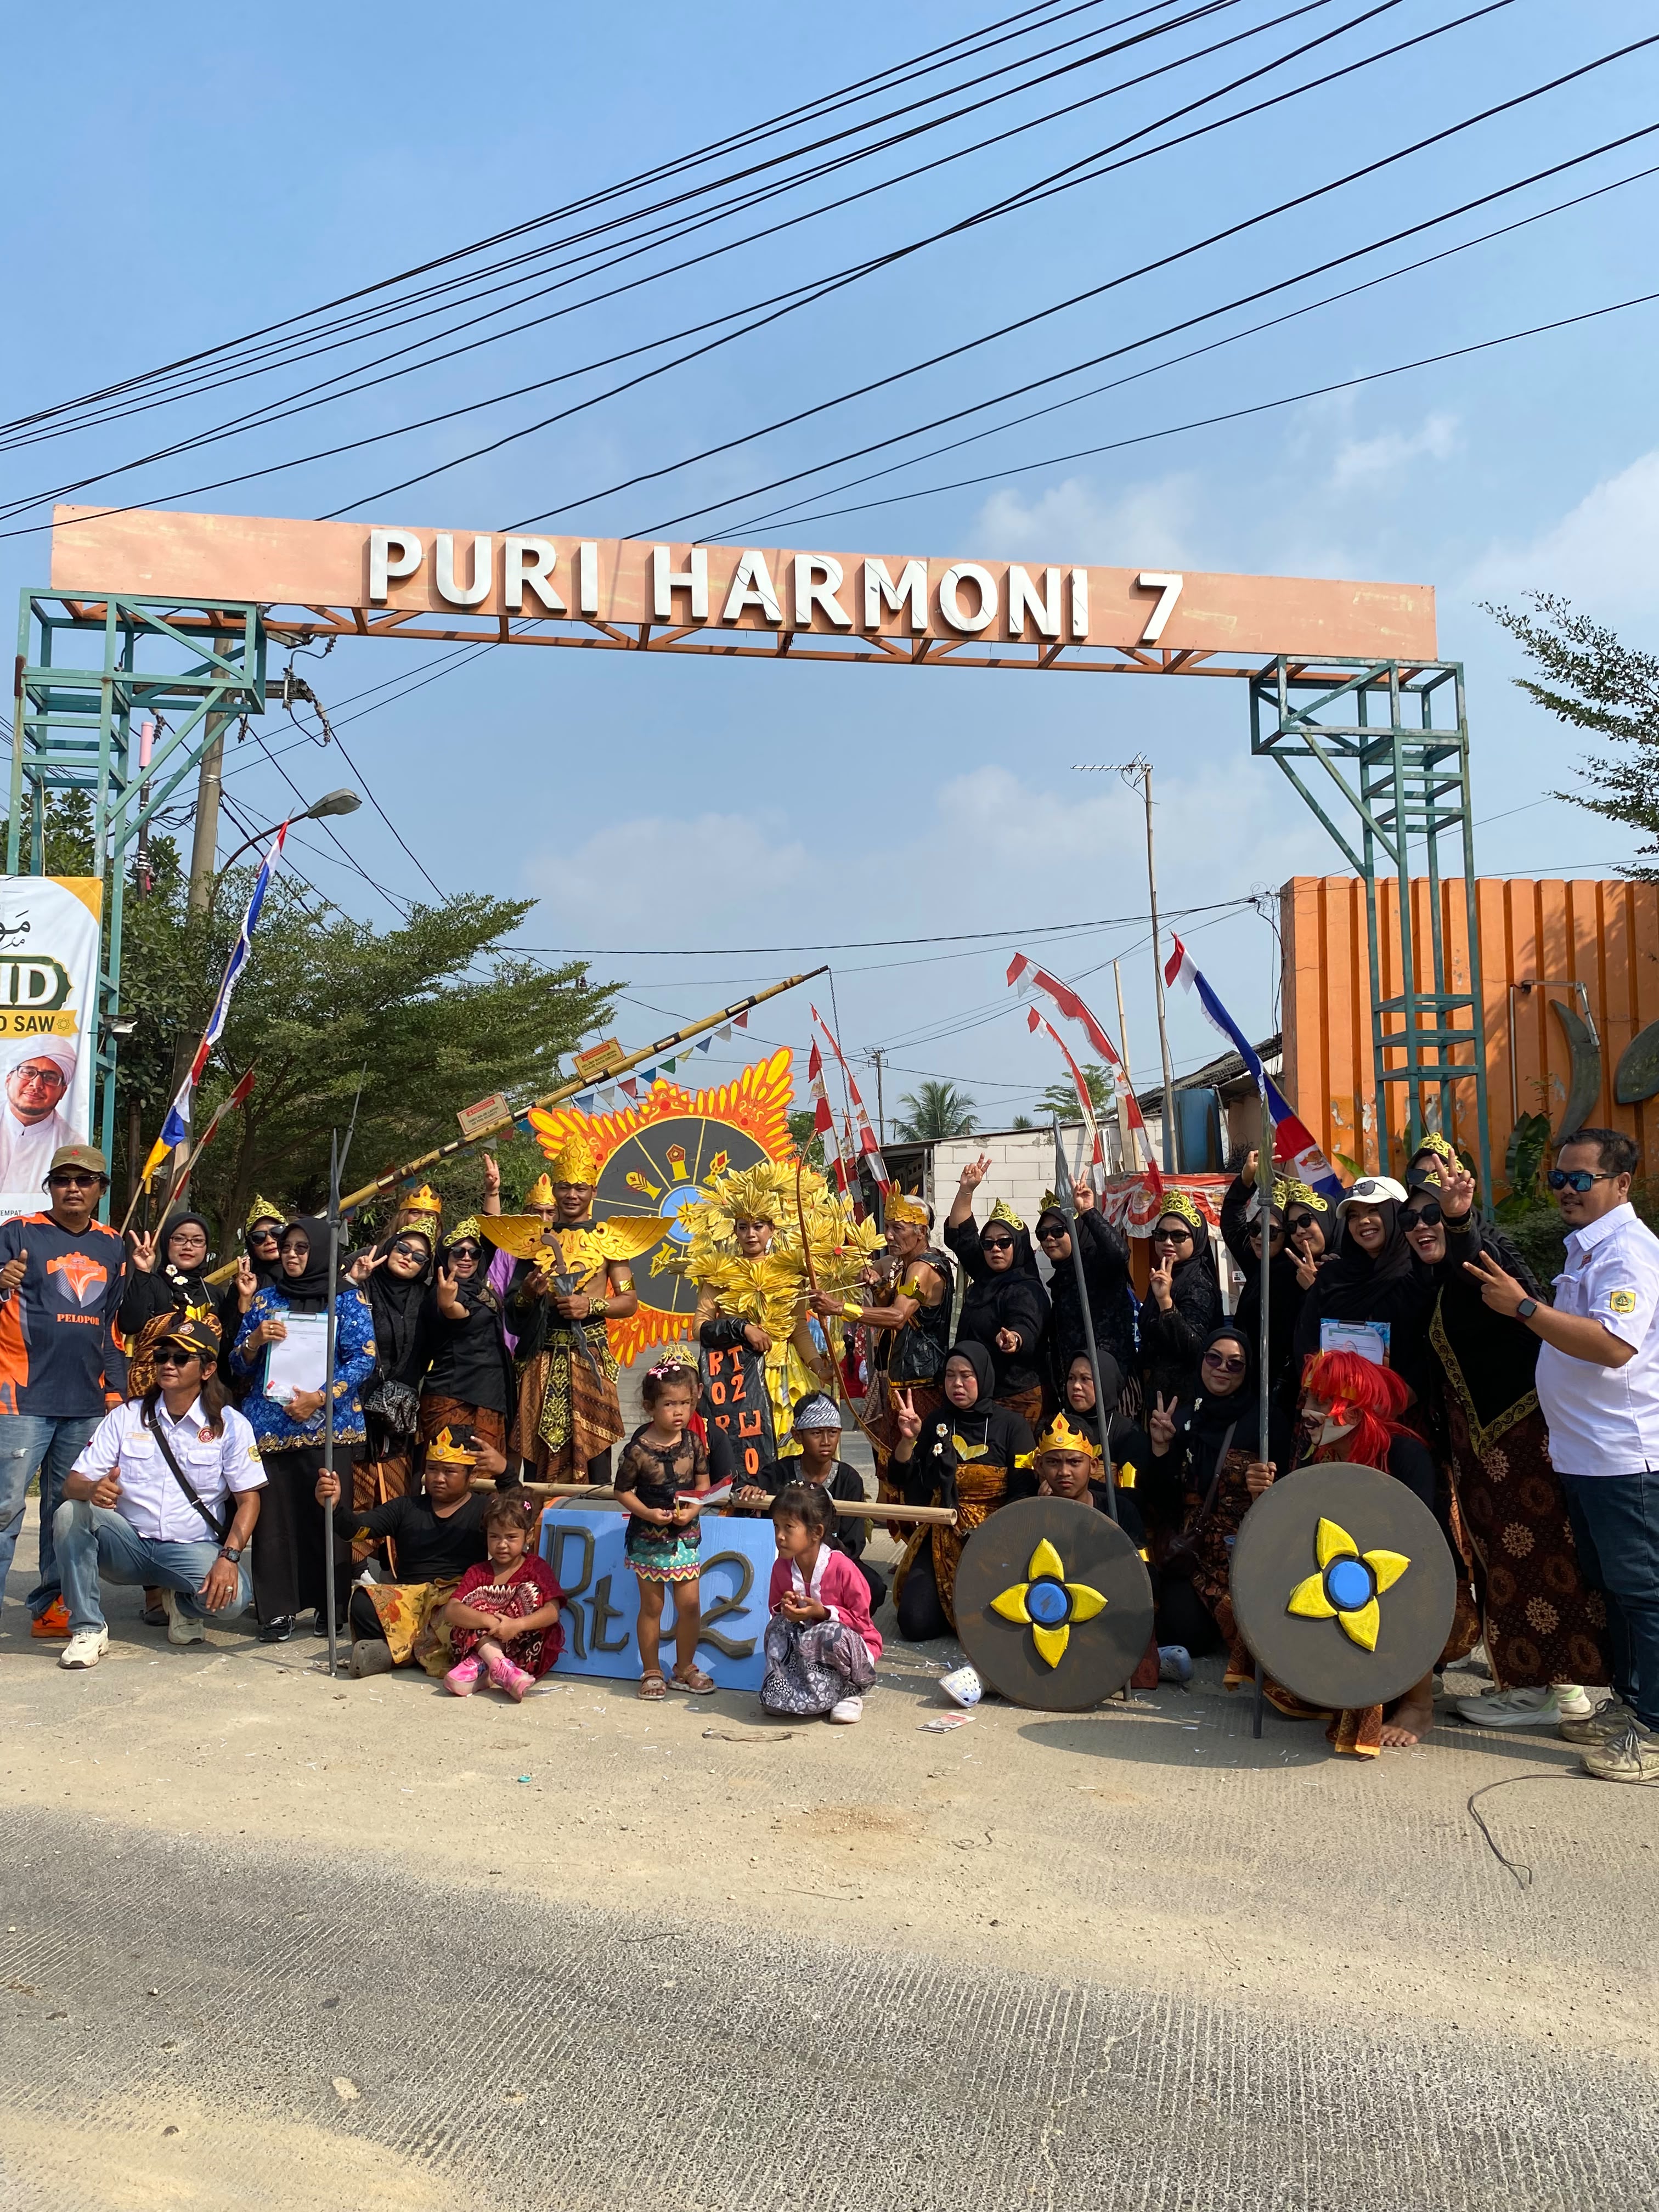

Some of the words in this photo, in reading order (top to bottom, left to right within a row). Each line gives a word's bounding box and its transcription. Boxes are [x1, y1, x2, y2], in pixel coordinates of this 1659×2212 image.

[369, 529, 598, 616] PURI
[653, 546, 1088, 640] HARMONI
[1137, 572, 1183, 643] 7
[14, 1015, 55, 1032] SAW
[57, 1313, 99, 1325] PELOPOR
[709, 1345, 744, 1376] RT
